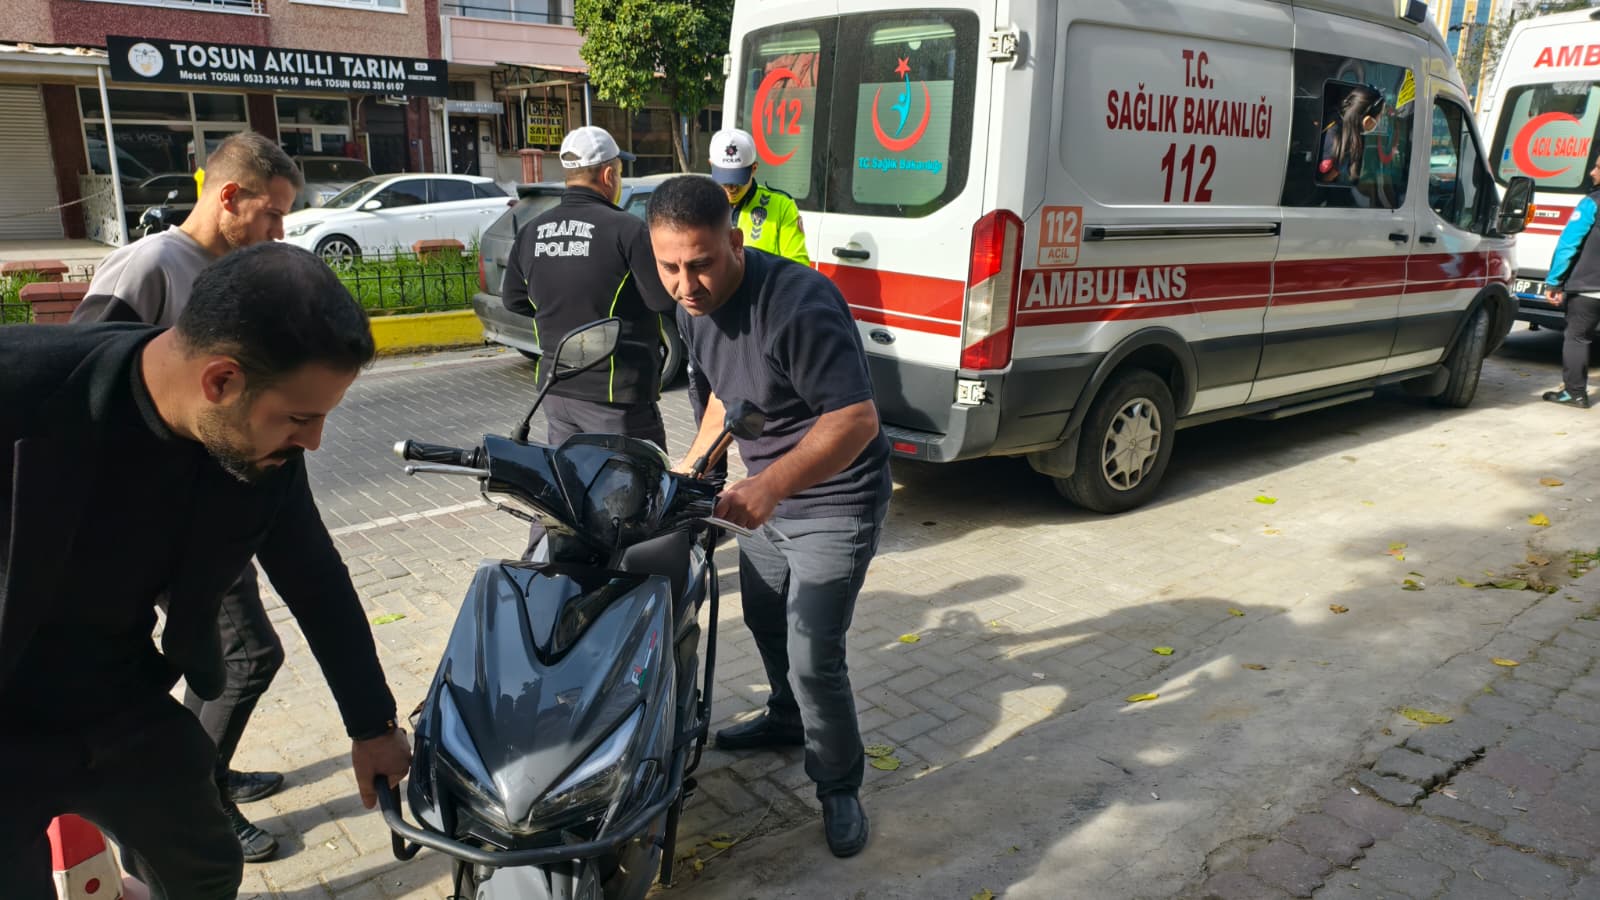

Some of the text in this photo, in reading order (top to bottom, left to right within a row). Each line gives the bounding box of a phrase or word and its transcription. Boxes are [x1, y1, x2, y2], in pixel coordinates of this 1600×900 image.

[170, 44, 406, 80] TOSUN AKILLI TARIM
[1181, 49, 1214, 89] T.C.
[1534, 44, 1600, 69] AMB
[179, 70, 207, 81] Mesut
[211, 72, 240, 83] TOSUN
[244, 74, 264, 84] 0533
[305, 78, 323, 88] Berk
[325, 79, 350, 89] TOSUN
[764, 98, 802, 136] 112
[1106, 82, 1272, 139] SAĞLIK BAKANLIĞI
[1554, 135, 1592, 158] SAĞLIK
[871, 157, 898, 173] Sağlık
[1160, 143, 1217, 203] 112
[1046, 211, 1078, 243] 112
[1025, 265, 1187, 308] AMBULANS
